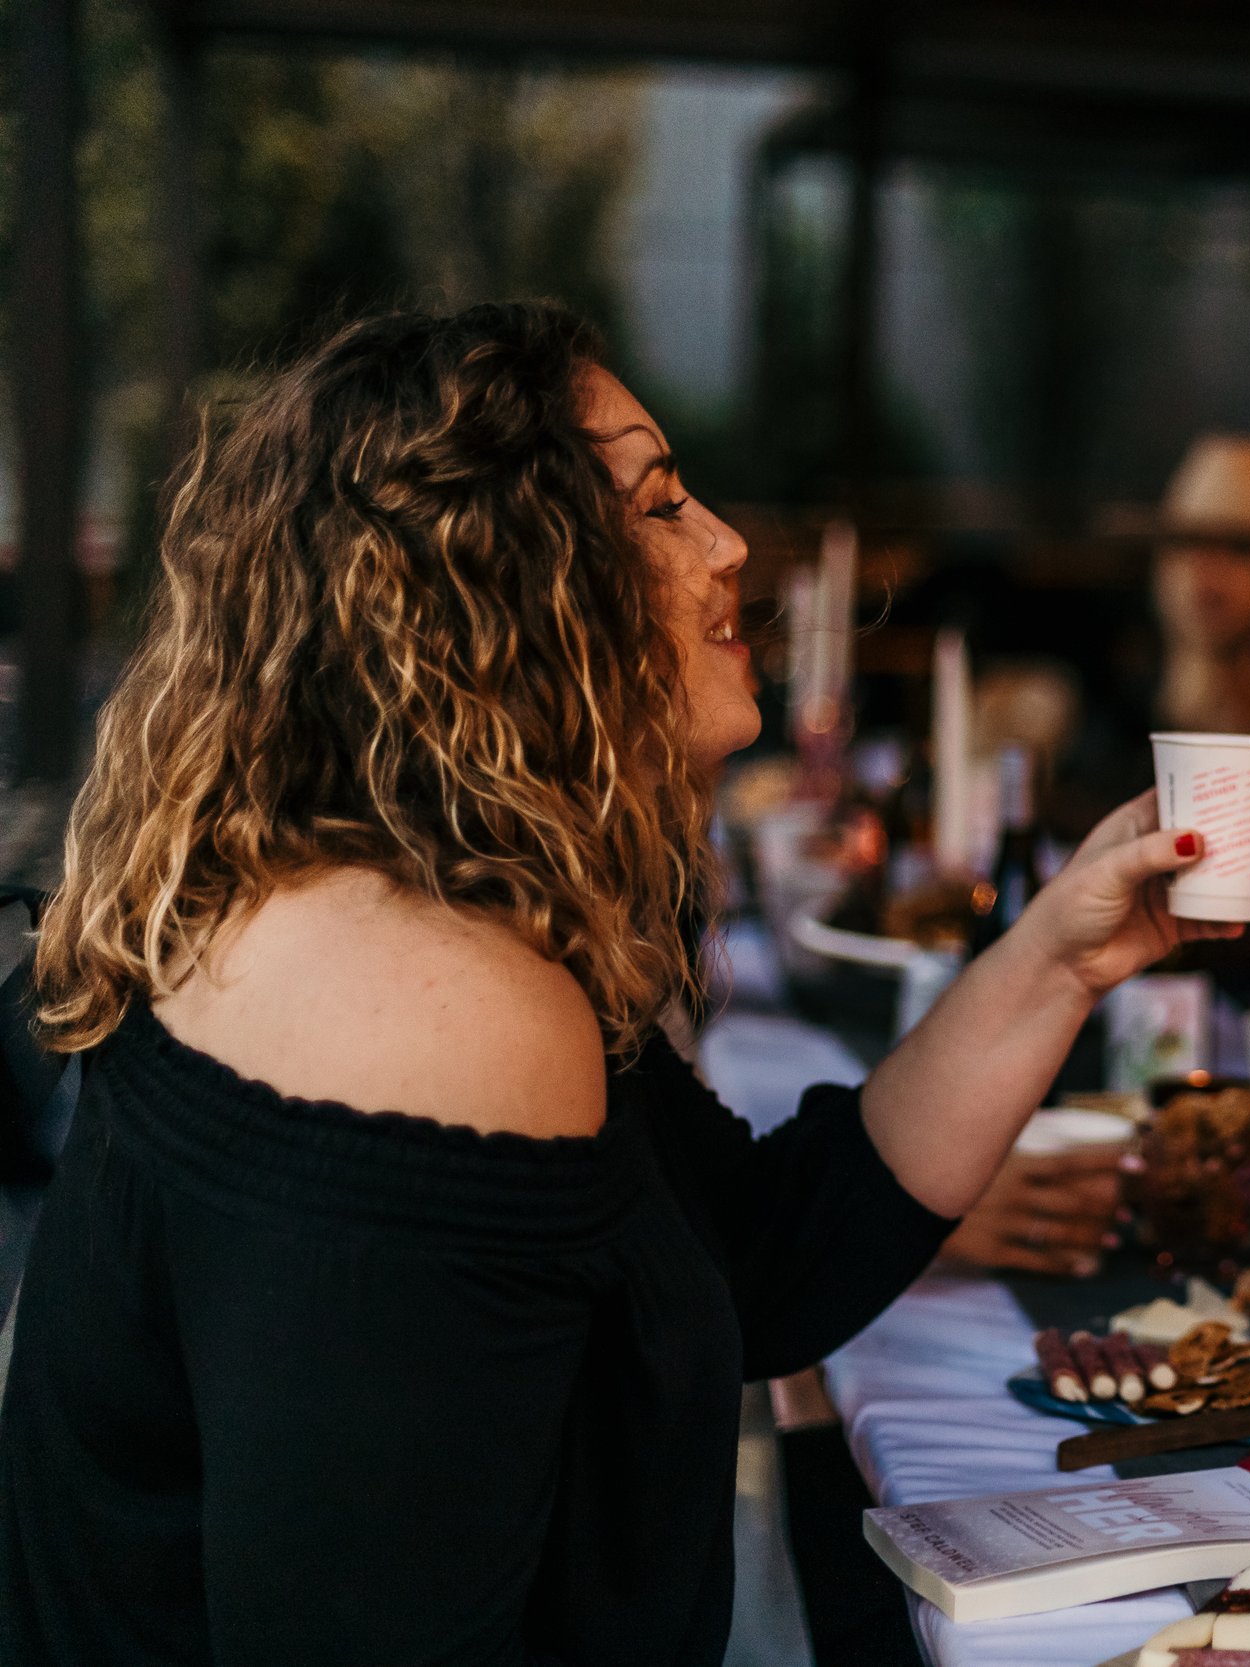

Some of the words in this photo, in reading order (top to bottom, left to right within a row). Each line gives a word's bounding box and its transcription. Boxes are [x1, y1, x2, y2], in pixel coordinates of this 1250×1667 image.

[900, 1513, 932, 1533] STEF
[925, 1535, 978, 1573] CALDWELL
[1045, 1488, 1184, 1543] HER
